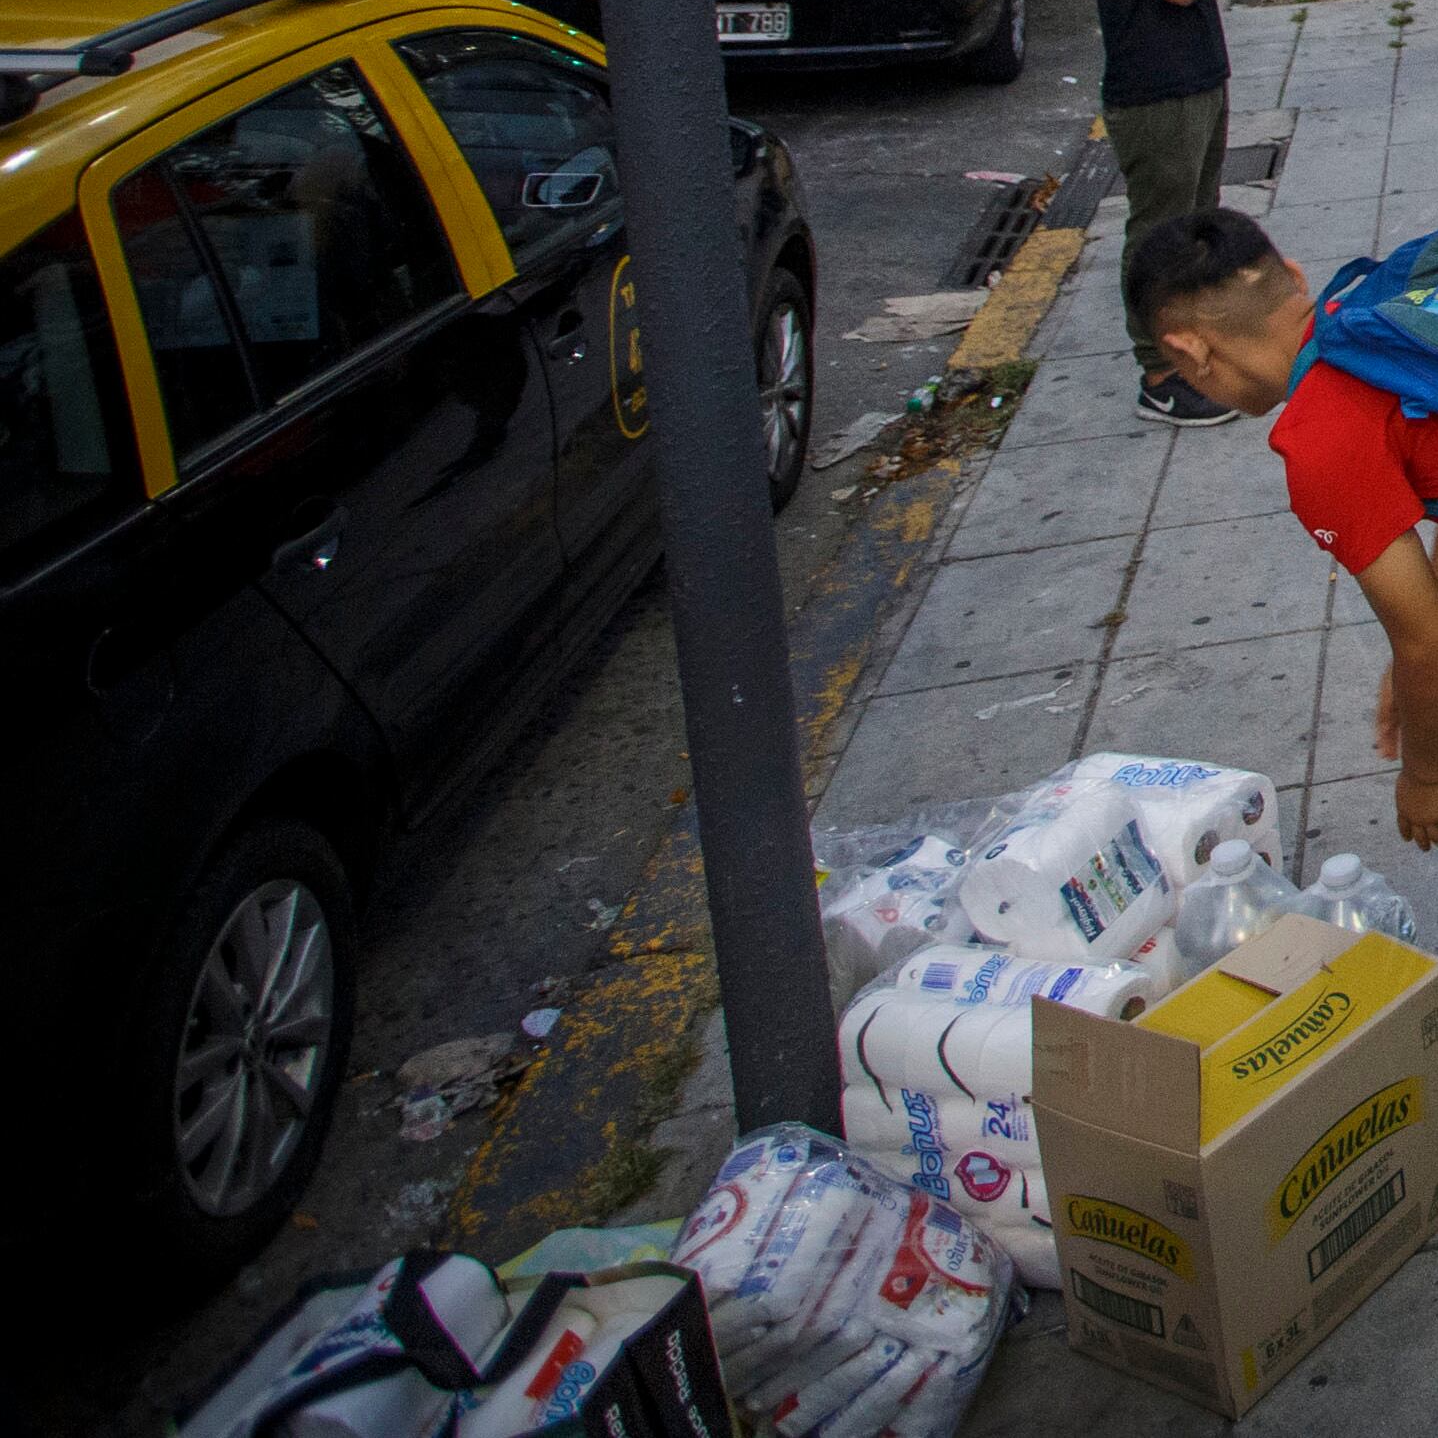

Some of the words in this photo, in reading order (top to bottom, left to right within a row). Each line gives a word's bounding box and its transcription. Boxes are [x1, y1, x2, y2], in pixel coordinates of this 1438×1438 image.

[1232, 991, 1350, 1079] Cañuelas
[987, 1101, 1011, 1139] 24
[1279, 1093, 1412, 1220] Cañuelas
[1068, 1200, 1181, 1266] Cañuelas
